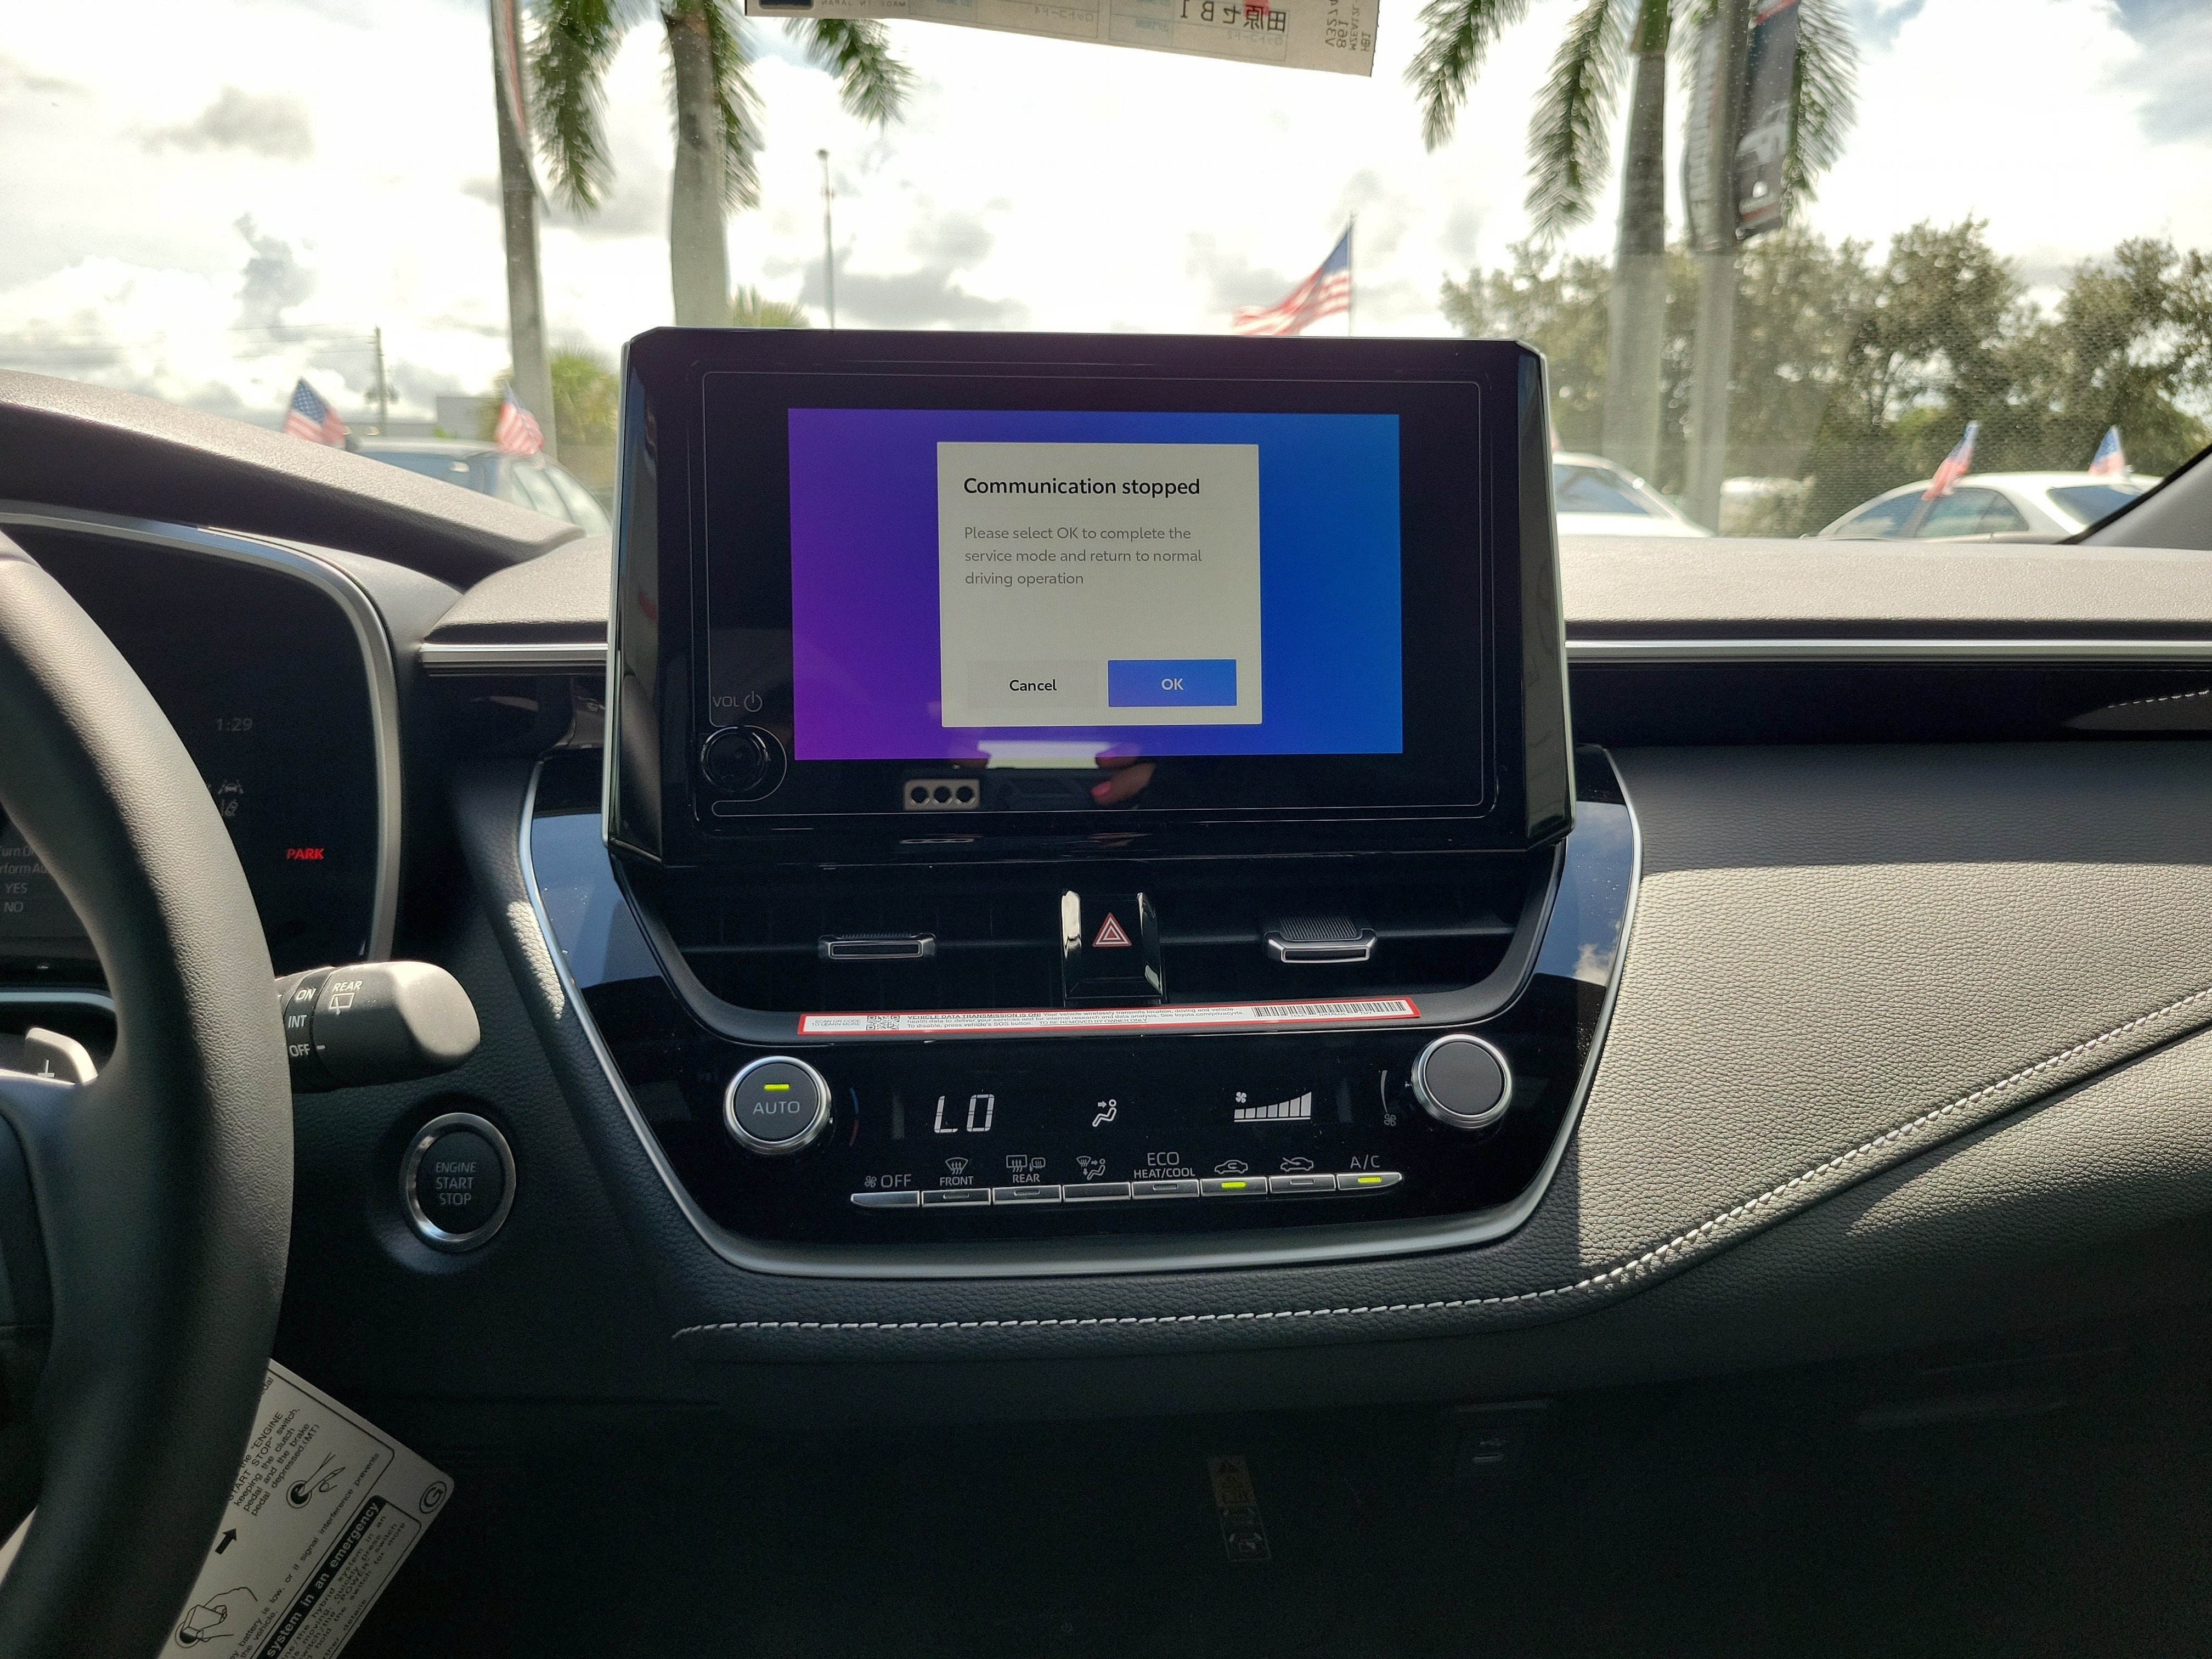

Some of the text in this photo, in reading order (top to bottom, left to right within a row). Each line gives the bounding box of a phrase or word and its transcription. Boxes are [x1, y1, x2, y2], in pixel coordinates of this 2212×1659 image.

[964, 478, 1200, 498] Communication stopped
[964, 527, 1191, 542] Please select OK to complete the
[964, 549, 1202, 562] service mode and return to normal
[964, 572, 1084, 586] driving operation
[1009, 679, 1057, 691] Cancel
[1161, 678, 1183, 690] OK
[714, 697, 739, 707] VOL
[218, 718, 252, 732] 1:29
[286, 848, 324, 860] PARK
[5, 882, 28, 894] YES
[4, 901, 24, 912] NO
[332, 980, 363, 992] REAR
[296, 988, 317, 1001] ON
[288, 1014, 307, 1028] INT
[289, 1043, 310, 1057] OFF
[753, 1101, 800, 1114] AUTO
[934, 1094, 995, 1133] LO
[1147, 1152, 1179, 1166] ECO
[1350, 1154, 1380, 1169] A/C
[436, 1161, 478, 1173] ENGINE
[1133, 1167, 1195, 1179] HEAT/COOL
[436, 1177, 475, 1189] START
[881, 1174, 912, 1188] OFF
[940, 1176, 973, 1186] FRONT
[1012, 1173, 1040, 1183] REAR
[440, 1193, 471, 1205] STOP
[276, 1409, 300, 1435] switch,
[234, 1429, 295, 1506] keeping the clutch
[244, 1424, 309, 1511] pedal and the brake
[251, 1491, 270, 1516] pedal
[238, 1618, 262, 1646] battery
[285, 1574, 292, 1582] or
[300, 1537, 319, 1561] signal
[320, 1489, 353, 1534] interference
[354, 1453, 379, 1486] prevents
[312, 1588, 335, 1618] hybrid
[337, 1546, 365, 1583] system
[365, 1534, 373, 1542] in
[377, 1516, 386, 1527] an
[267, 1503, 378, 1656] system in an emergency
[300, 1612, 335, 1659] witch/the
[240, 1645, 252, 1658] the
